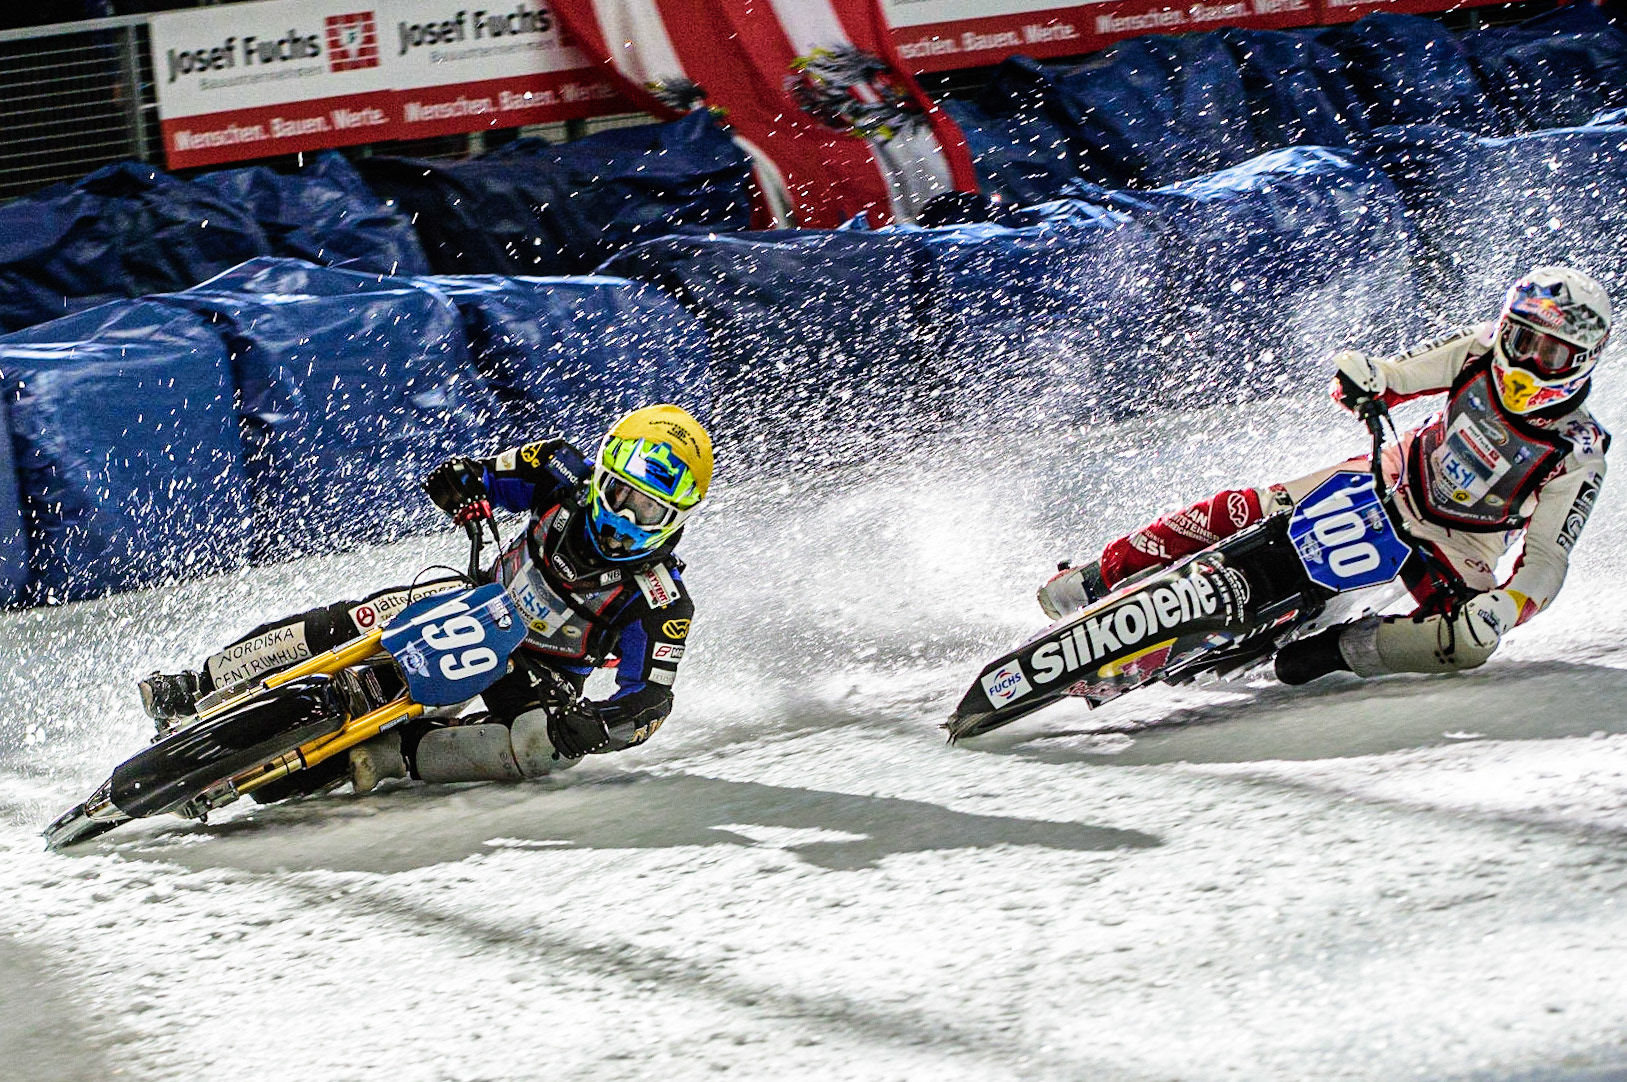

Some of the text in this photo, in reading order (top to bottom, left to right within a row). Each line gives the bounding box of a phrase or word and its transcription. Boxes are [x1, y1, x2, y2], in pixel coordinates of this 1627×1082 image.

[167, 36, 236, 84] Josef
[244, 28, 322, 66] Fuchs
[397, 9, 467, 55] Josef
[473, 3, 550, 39] Fuchs
[173, 106, 390, 151] Menschen. Bauen. Werte.
[1302, 481, 1382, 578] 100
[219, 629, 294, 667] NORDISKA
[410, 592, 499, 681] 199
[1030, 575, 1218, 685] silkolene
[988, 671, 1022, 697] FUCHS
